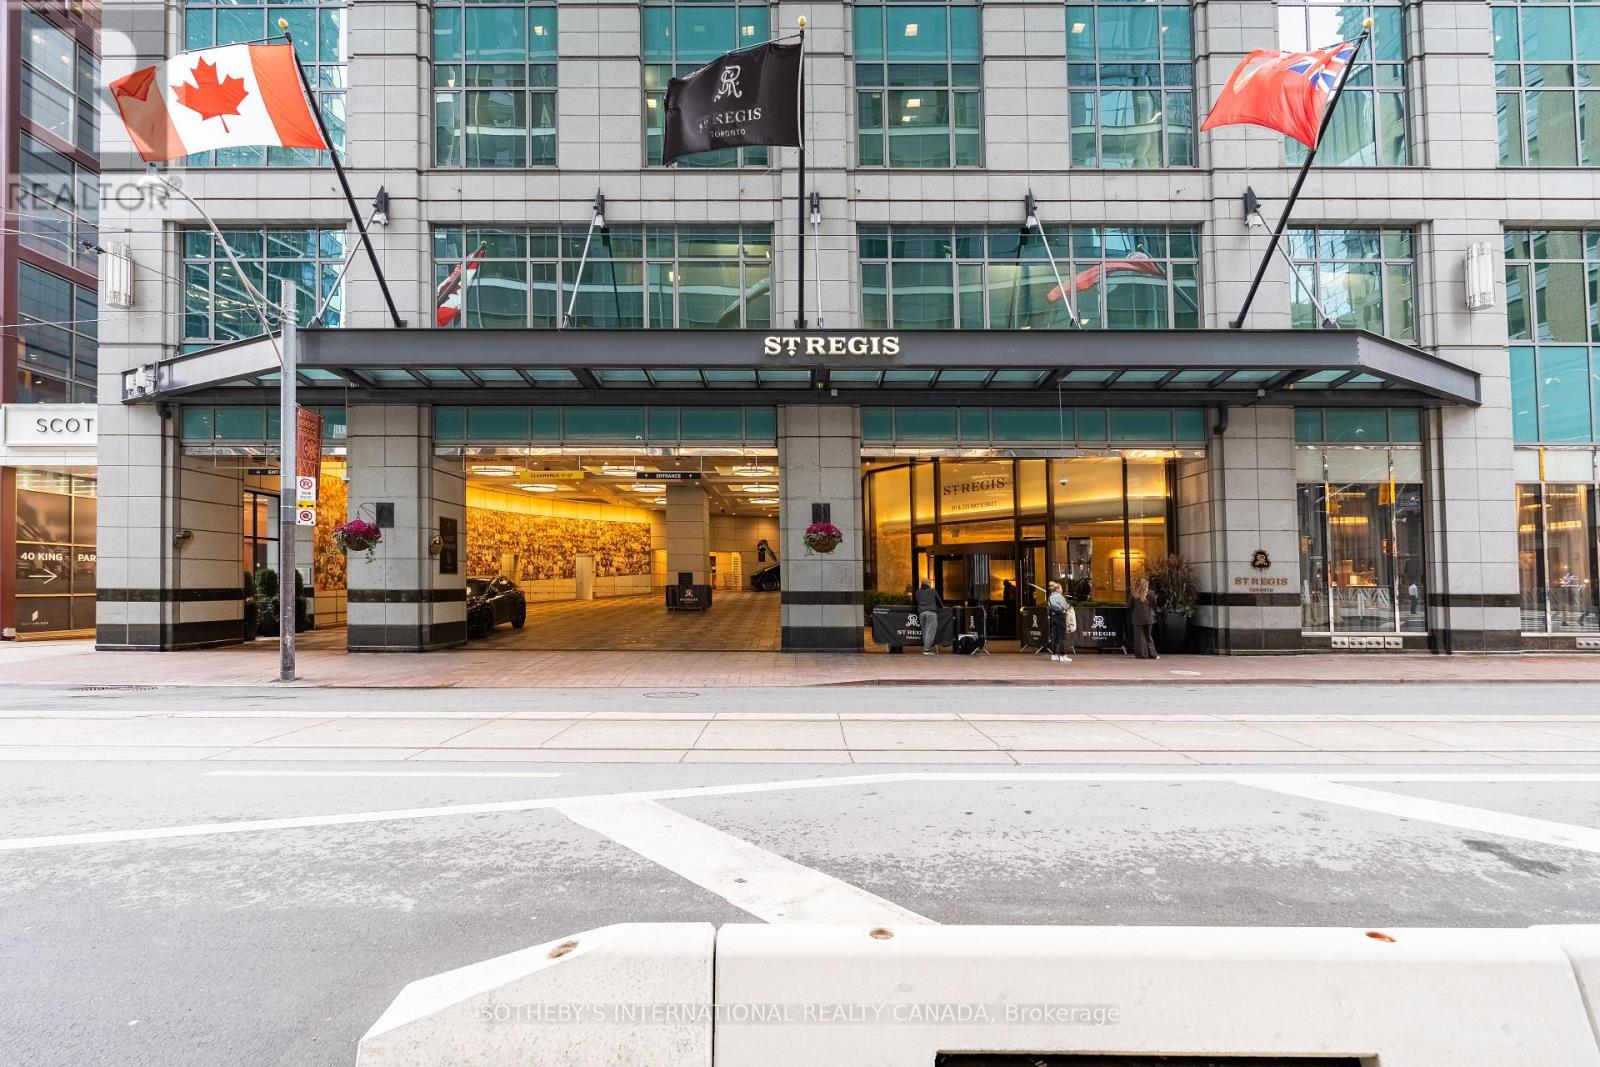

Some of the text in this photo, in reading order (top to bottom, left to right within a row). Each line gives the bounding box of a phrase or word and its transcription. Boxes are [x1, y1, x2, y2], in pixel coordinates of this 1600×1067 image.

[712, 107, 762, 124] REGIS
[711, 128, 746, 138] TORONTO
[764, 336, 900, 356] ST REGIS
[36, 417, 95, 433] SCOT
[943, 477, 1006, 496] ST REGIS
[20, 552, 35, 560] 40
[37, 553, 63, 561] KING
[1234, 577, 1289, 586] ST REGIS
